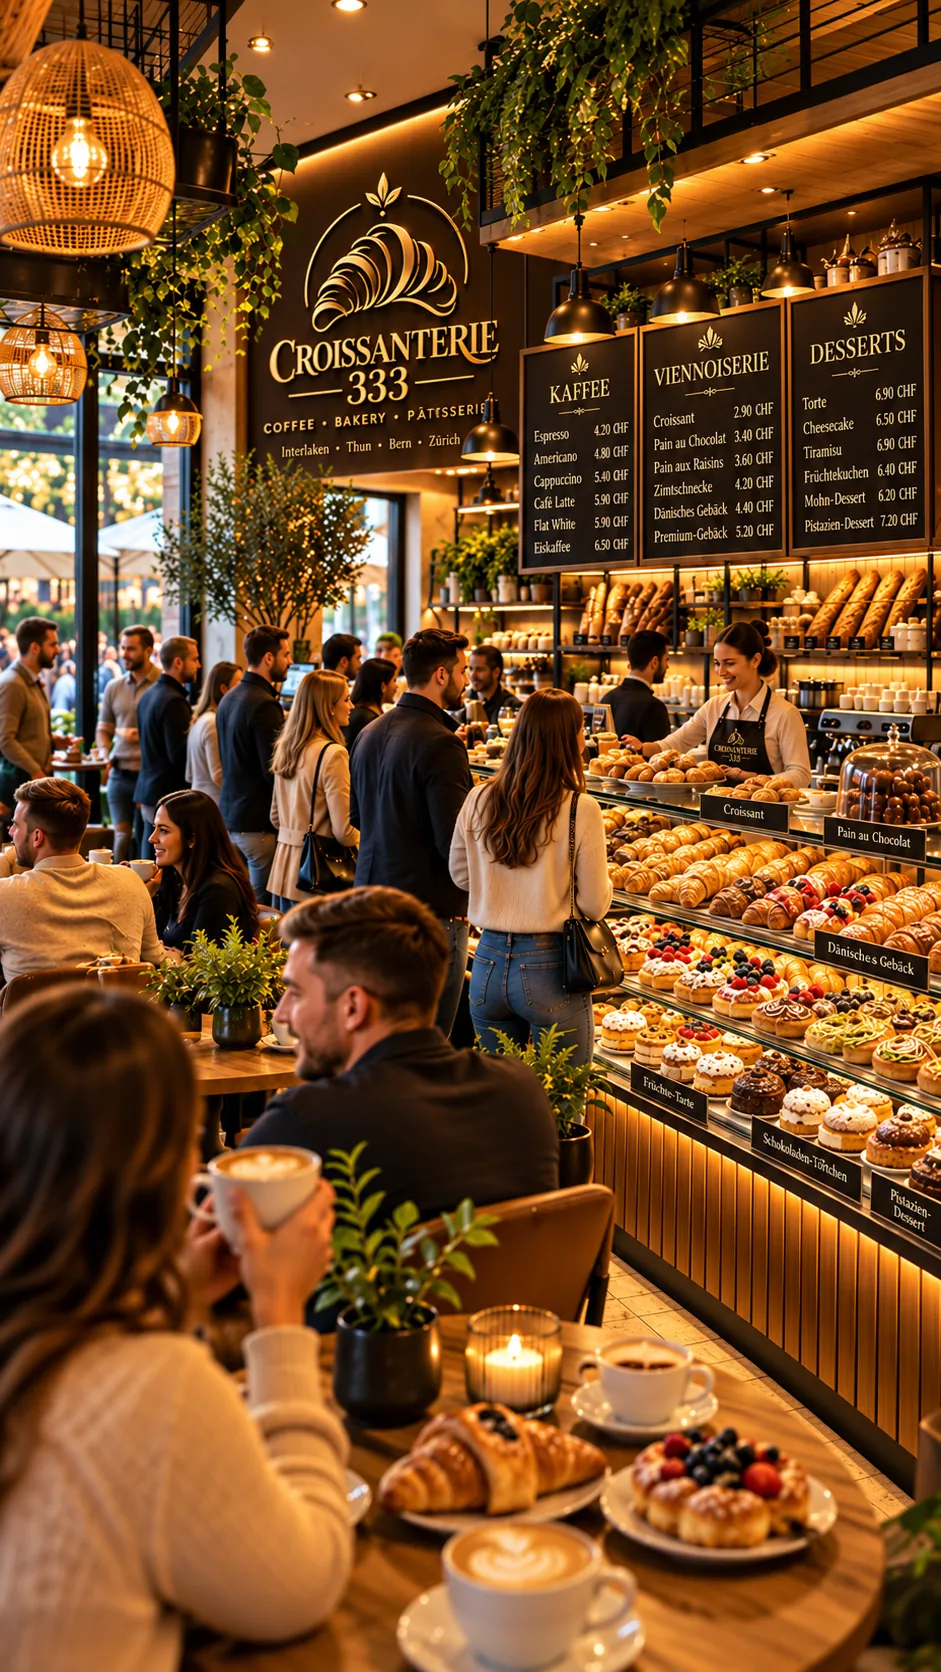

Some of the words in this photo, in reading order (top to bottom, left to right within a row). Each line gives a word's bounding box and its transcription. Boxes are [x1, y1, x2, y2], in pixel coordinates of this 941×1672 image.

[269, 320, 499, 384] CROISSANTERIE
[810, 329, 906, 365] DESSERTS
[654, 351, 769, 386] VIENNOISERIE
[347, 367, 408, 405] 333
[550, 378, 610, 404] KAFFEE
[802, 396, 827, 410] Torte
[875, 386, 894, 401] 6.90
[897, 383, 917, 398] CHF
[263, 418, 314, 434] COFFEE
[335, 412, 386, 428] BAKERY
[653, 412, 695, 428] Croissant
[734, 405, 752, 419] 2.90
[755, 402, 774, 416] CHF
[803, 417, 854, 435] Cheesecake
[876, 412, 894, 426] 6.50
[898, 409, 917, 424] CHF
[534, 429, 569, 444] Espresso
[594, 424, 611, 437] 4.20
[613, 422, 629, 434] CHF
[654, 437, 673, 451] Pain
[675, 437, 686, 449] au
[688, 432, 726, 448] Chocolat
[734, 429, 752, 443] 3.40
[756, 427, 774, 441] CHF
[282, 444, 329, 458] Interlaken
[346, 441, 371, 453] Thun
[389, 438, 412, 450] Bern
[429, 433, 460, 447] Zürich
[534, 452, 578, 465] Americano
[594, 447, 611, 460] 4.80
[613, 445, 629, 458] CHF
[803, 444, 842, 459] Tiramisu
[877, 437, 895, 452] 6.90
[898, 435, 917, 450] CHF
[654, 460, 673, 474] Pain
[675, 459, 691, 472] aux
[693, 456, 724, 470] Raisins
[735, 454, 753, 467] 3.60
[756, 451, 774, 465] CHF
[804, 466, 869, 483] Früchtekuchen
[877, 463, 896, 477] 6.40
[898, 461, 917, 475] CHF
[534, 473, 582, 489] Cappuccino
[594, 471, 611, 483] 5.40
[613, 469, 629, 481] CHF
[653, 480, 713, 497] Zimtschnecke
[735, 478, 753, 490] 4.20
[756, 475, 774, 489] CHF
[534, 497, 552, 510] Café
[555, 496, 575, 509] Latte
[594, 494, 611, 506] 5.90
[613, 492, 629, 504] CHF
[804, 490, 866, 508] Mohn-Dessert
[878, 489, 896, 502] 6.20
[899, 486, 917, 500] CHF
[654, 504, 695, 520] Dänisches
[697, 502, 728, 517] Gebäck
[735, 501, 753, 514] 4.40
[756, 500, 774, 513] CHF
[534, 519, 549, 532] Flat
[551, 518, 576, 531] White
[594, 518, 611, 529] 5.90
[613, 516, 629, 527] CHF
[654, 525, 728, 544] Premium-Gebäck
[735, 526, 753, 538] 5.20
[756, 524, 774, 537] CHF
[805, 515, 874, 533] Pistazien-Dessert
[880, 514, 898, 528] 7.20
[900, 513, 918, 526] CHF
[534, 540, 570, 554] Eiskaffee
[594, 540, 611, 551] 6.50
[613, 539, 629, 550] CHF
[723, 804, 764, 820] Croissant
[837, 826, 856, 840] Pain
[858, 831, 869, 842] au
[872, 831, 912, 848] Chocolat
[828, 941, 877, 965] Dänisches
[879, 954, 915, 976] Gebäck
[889, 1188, 932, 1220] Pistazien-
[892, 1203, 927, 1233] Dessert
